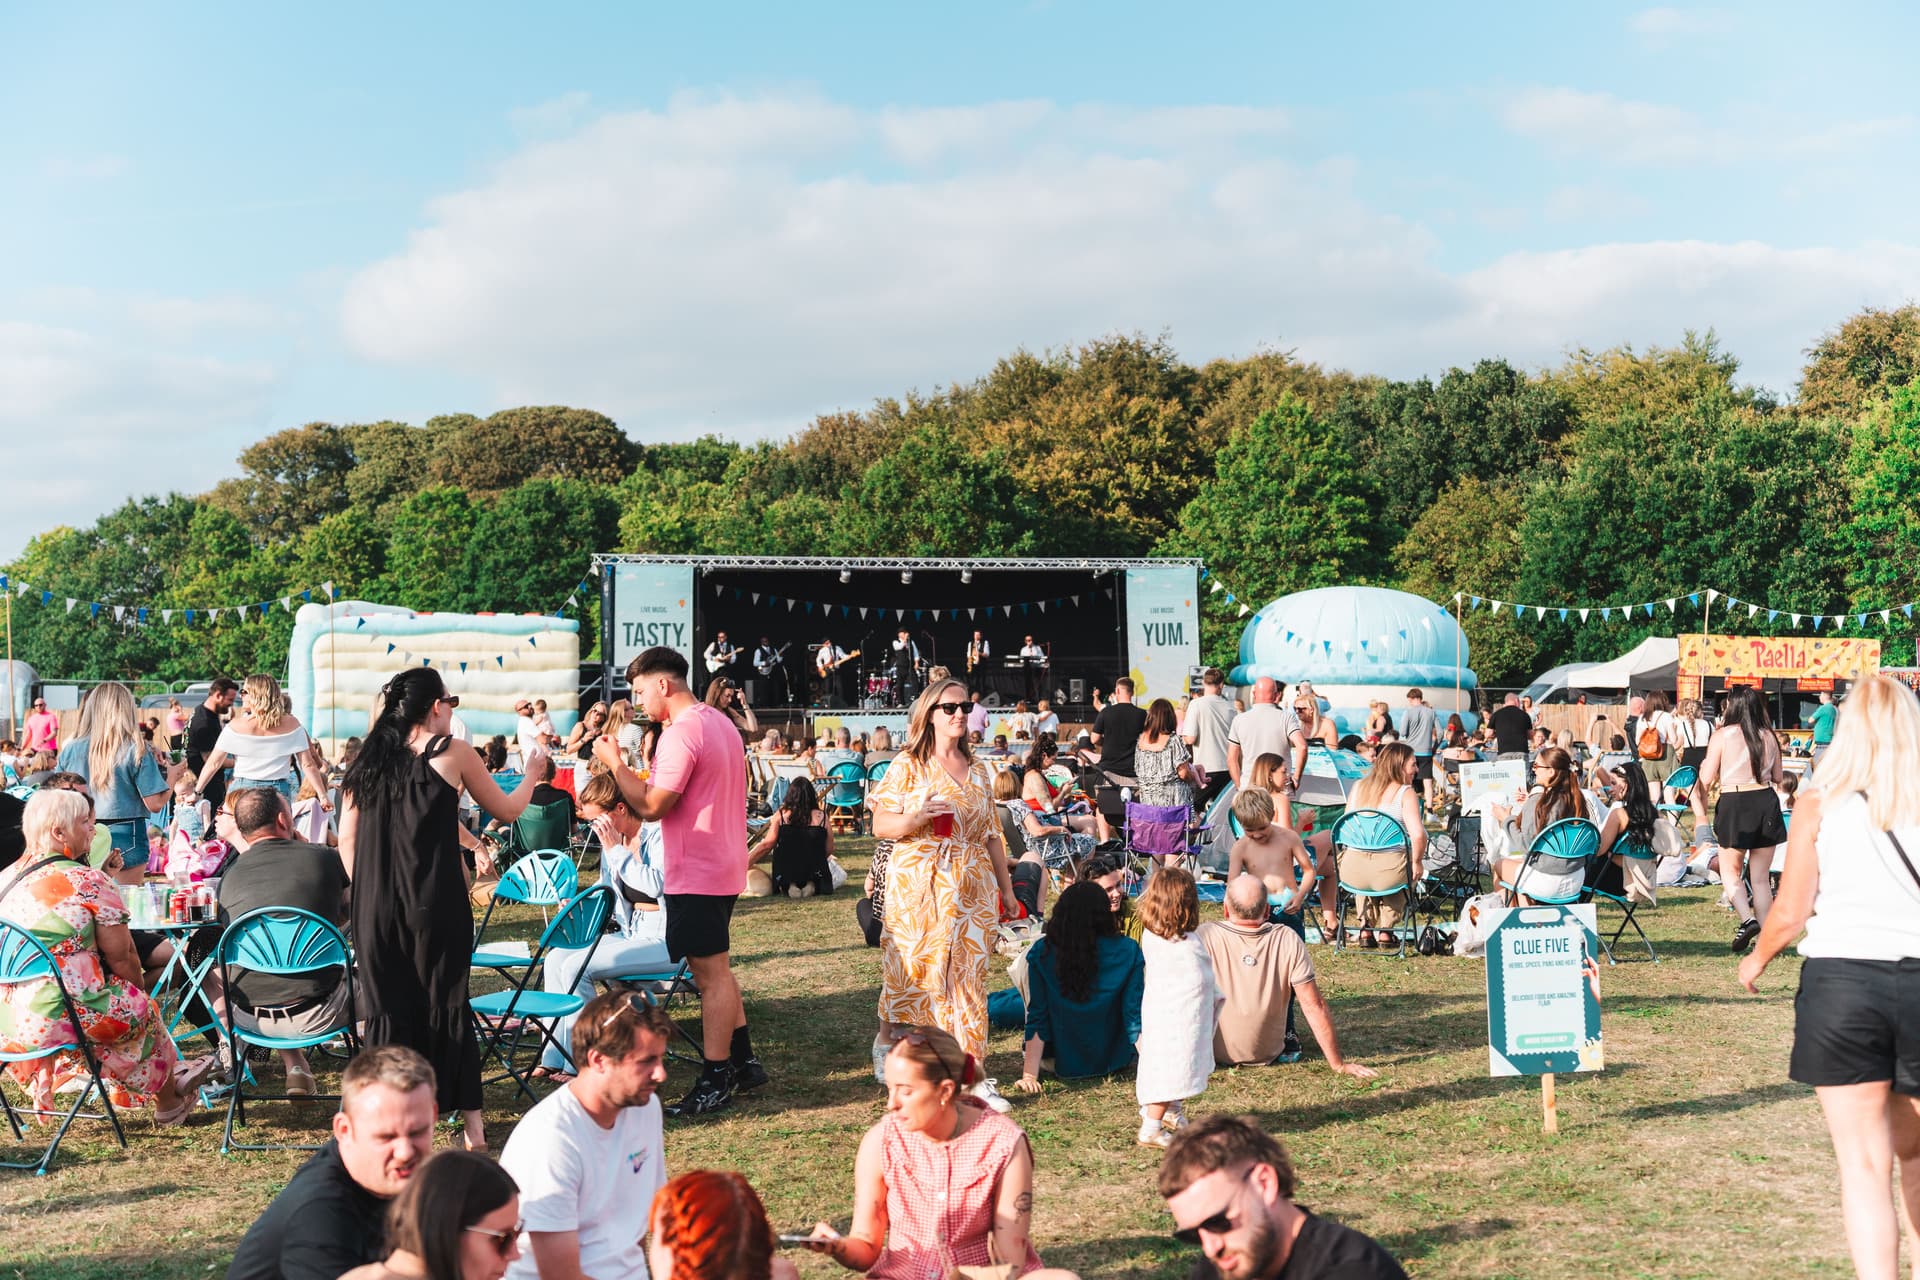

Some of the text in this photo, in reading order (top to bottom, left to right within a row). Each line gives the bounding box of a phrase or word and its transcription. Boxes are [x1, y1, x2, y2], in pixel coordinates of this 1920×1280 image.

[622, 622, 687, 647] TASTY.
[1142, 622, 1189, 647] YUM.
[1750, 641, 1807, 669] Paella
[1513, 938, 1570, 955] CLUE FIVE
